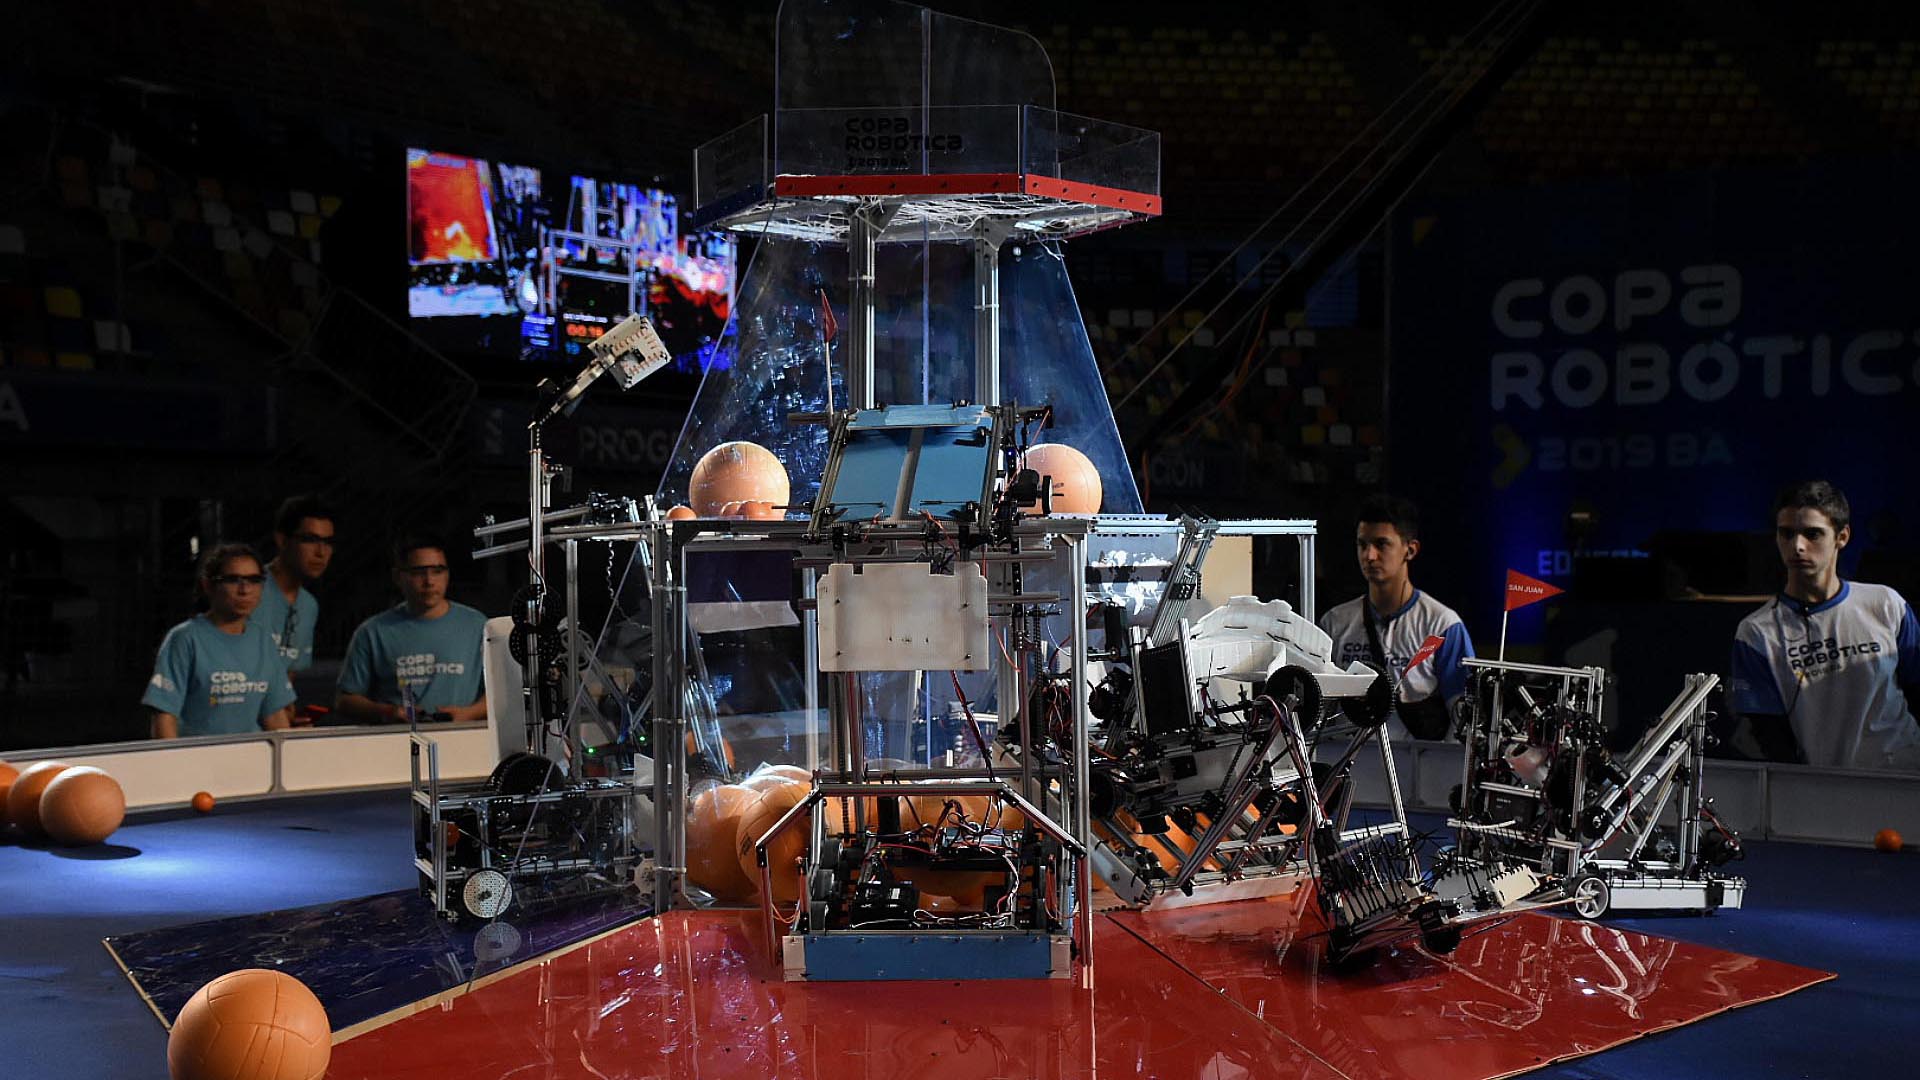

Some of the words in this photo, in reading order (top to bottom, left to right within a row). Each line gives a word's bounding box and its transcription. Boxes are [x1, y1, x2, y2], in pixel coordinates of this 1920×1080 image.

[1536, 433, 1656, 472] 2019
[1664, 431, 1738, 467] BA
[1506, 584, 1524, 593] SAN
[1524, 585, 1545, 595] JUAN
